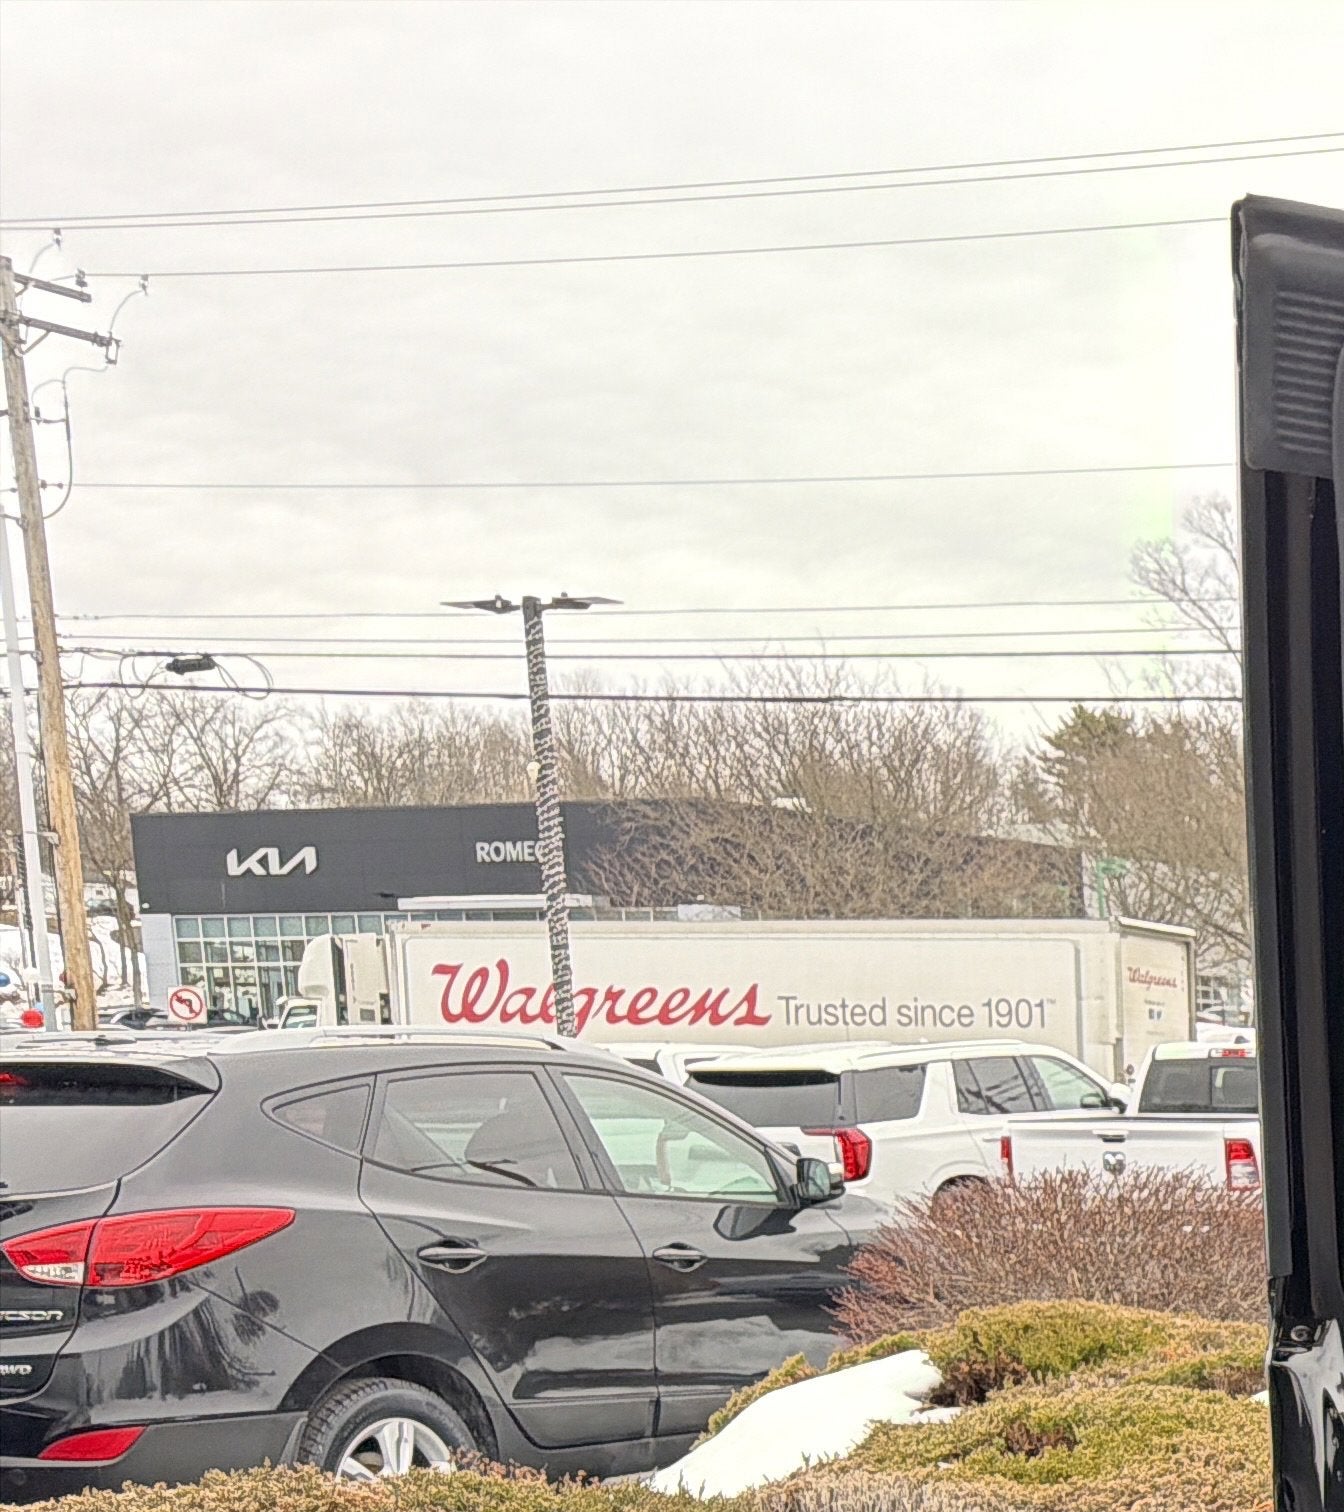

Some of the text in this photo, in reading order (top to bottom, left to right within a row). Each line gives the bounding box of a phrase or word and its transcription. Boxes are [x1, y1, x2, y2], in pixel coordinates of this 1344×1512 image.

[431, 958, 773, 1038] Walgreens
[777, 995, 887, 1027] Trusted
[896, 996, 975, 1028] since
